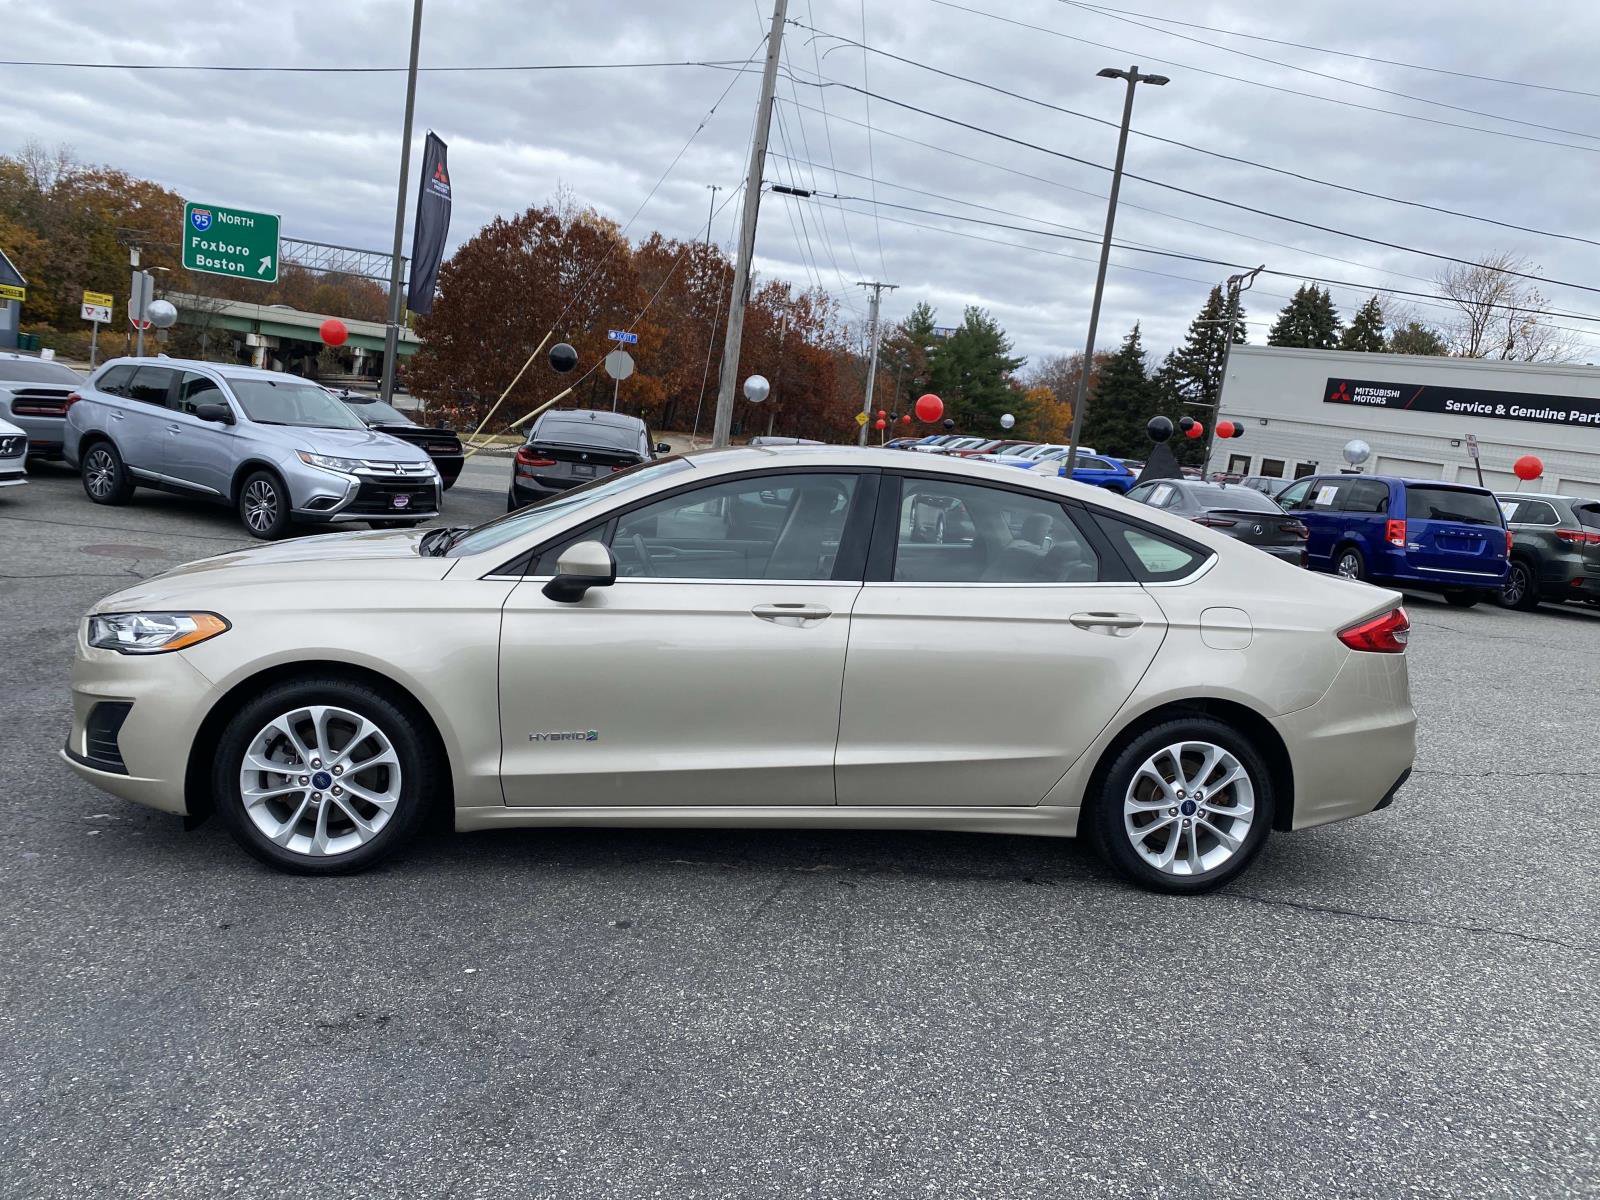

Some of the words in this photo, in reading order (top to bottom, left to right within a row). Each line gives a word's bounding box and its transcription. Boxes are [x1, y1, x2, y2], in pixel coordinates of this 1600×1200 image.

[194, 214, 209, 227] 95
[192, 236, 250, 256] Foxboro
[196, 254, 245, 272] Boston
[1354, 387, 1400, 398] MITSUBISHI
[1353, 395, 1387, 405] MOTORS
[1445, 400, 1493, 414] Service
[1495, 404, 1506, 415] &
[1509, 405, 1566, 420] Genuine
[529, 731, 586, 741] HYBRID
